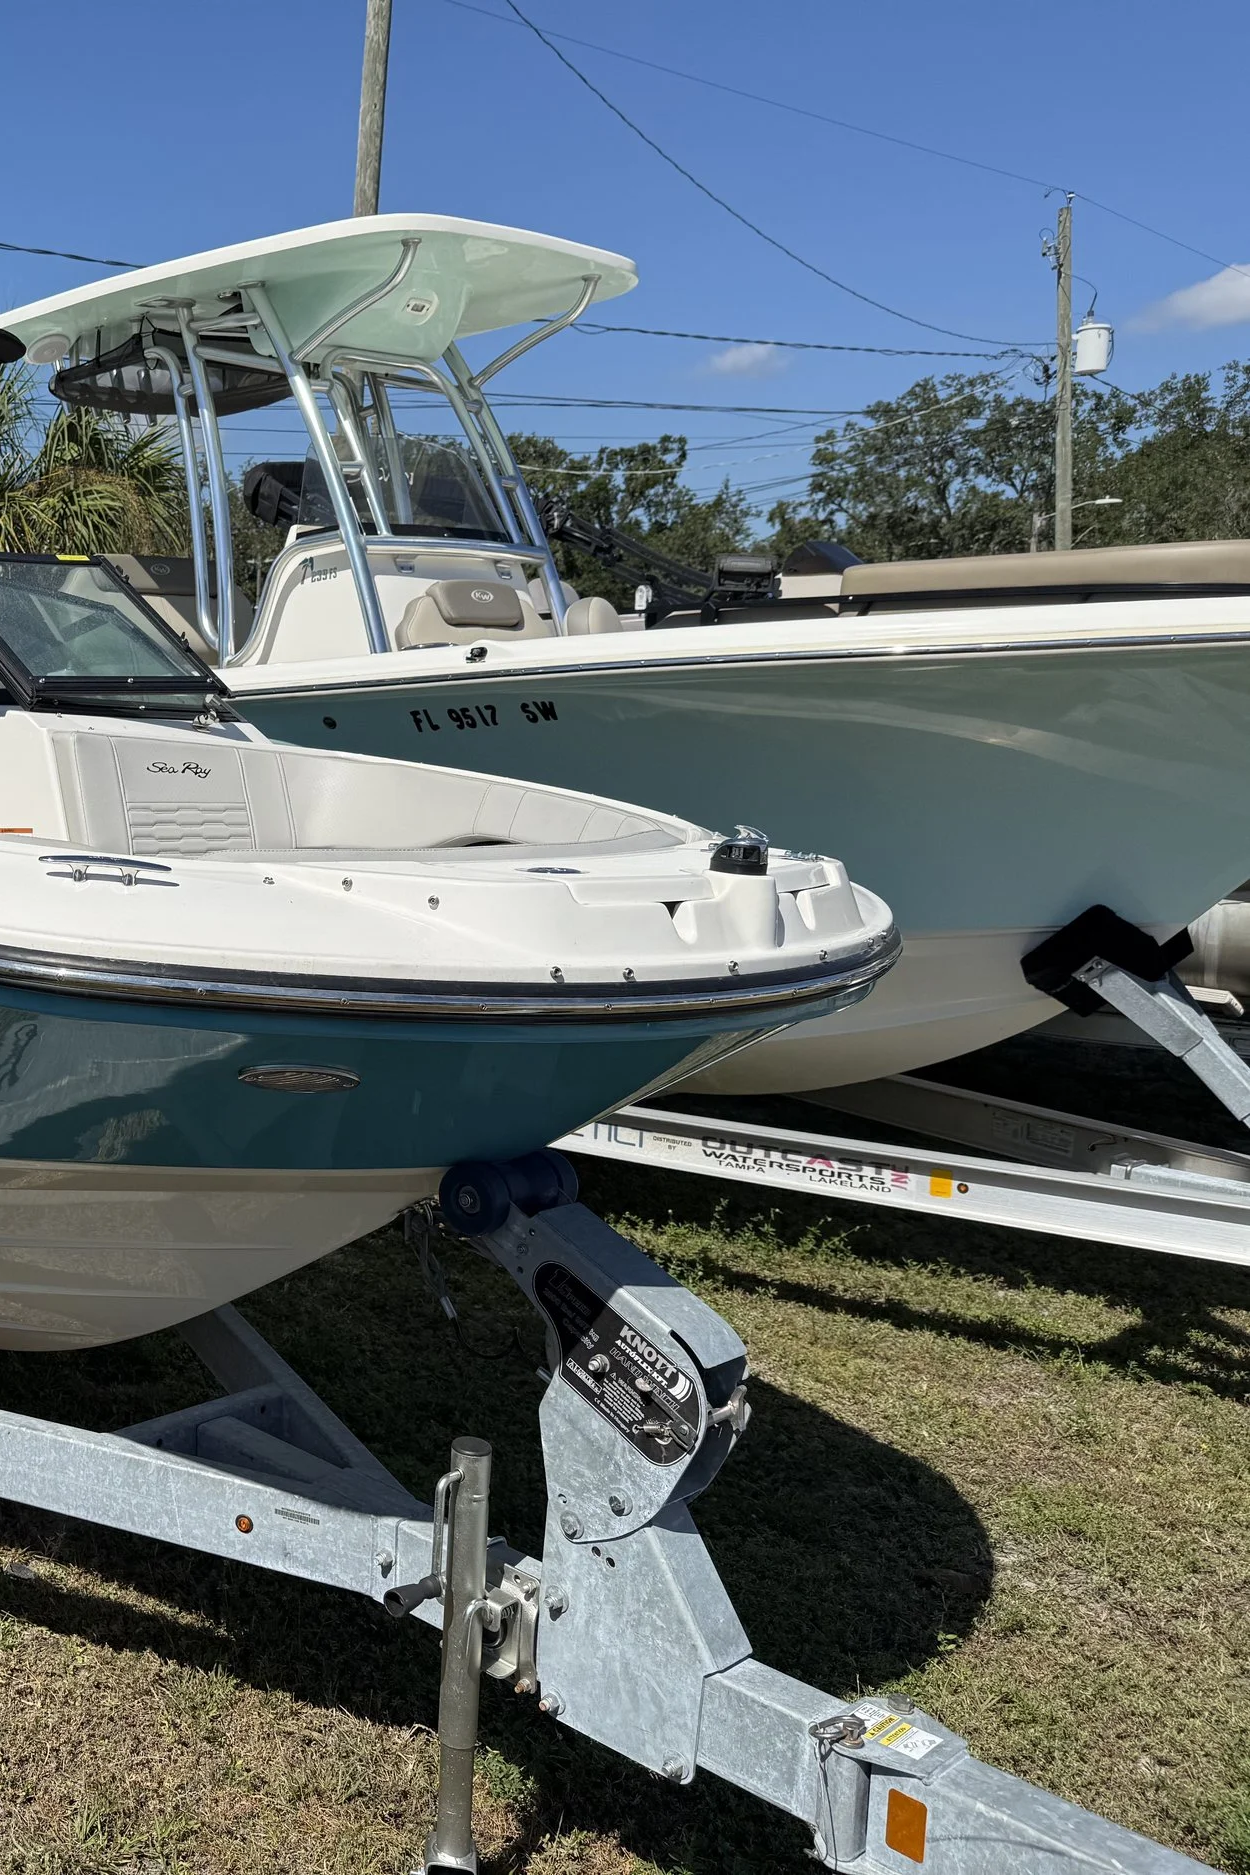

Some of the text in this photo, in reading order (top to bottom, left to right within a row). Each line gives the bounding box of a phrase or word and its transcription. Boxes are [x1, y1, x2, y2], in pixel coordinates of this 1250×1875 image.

[475, 591, 490, 600] KW
[409, 701, 558, 732] FL 9517 SW
[146, 761, 211, 778] Sea Ray
[652, 1135, 692, 1148] DISTRIBUTED
[701, 1135, 890, 1175] OUTCAST
[701, 1148, 886, 1186] WATERSPORTS
[717, 1159, 766, 1174] TAMPA
[809, 1175, 891, 1193] LAKELAND
[608, 1346, 643, 1378] HAND
[614, 1336, 669, 1388] AUTÓFLEX KFT.
[619, 1324, 677, 1379] KNOTT
